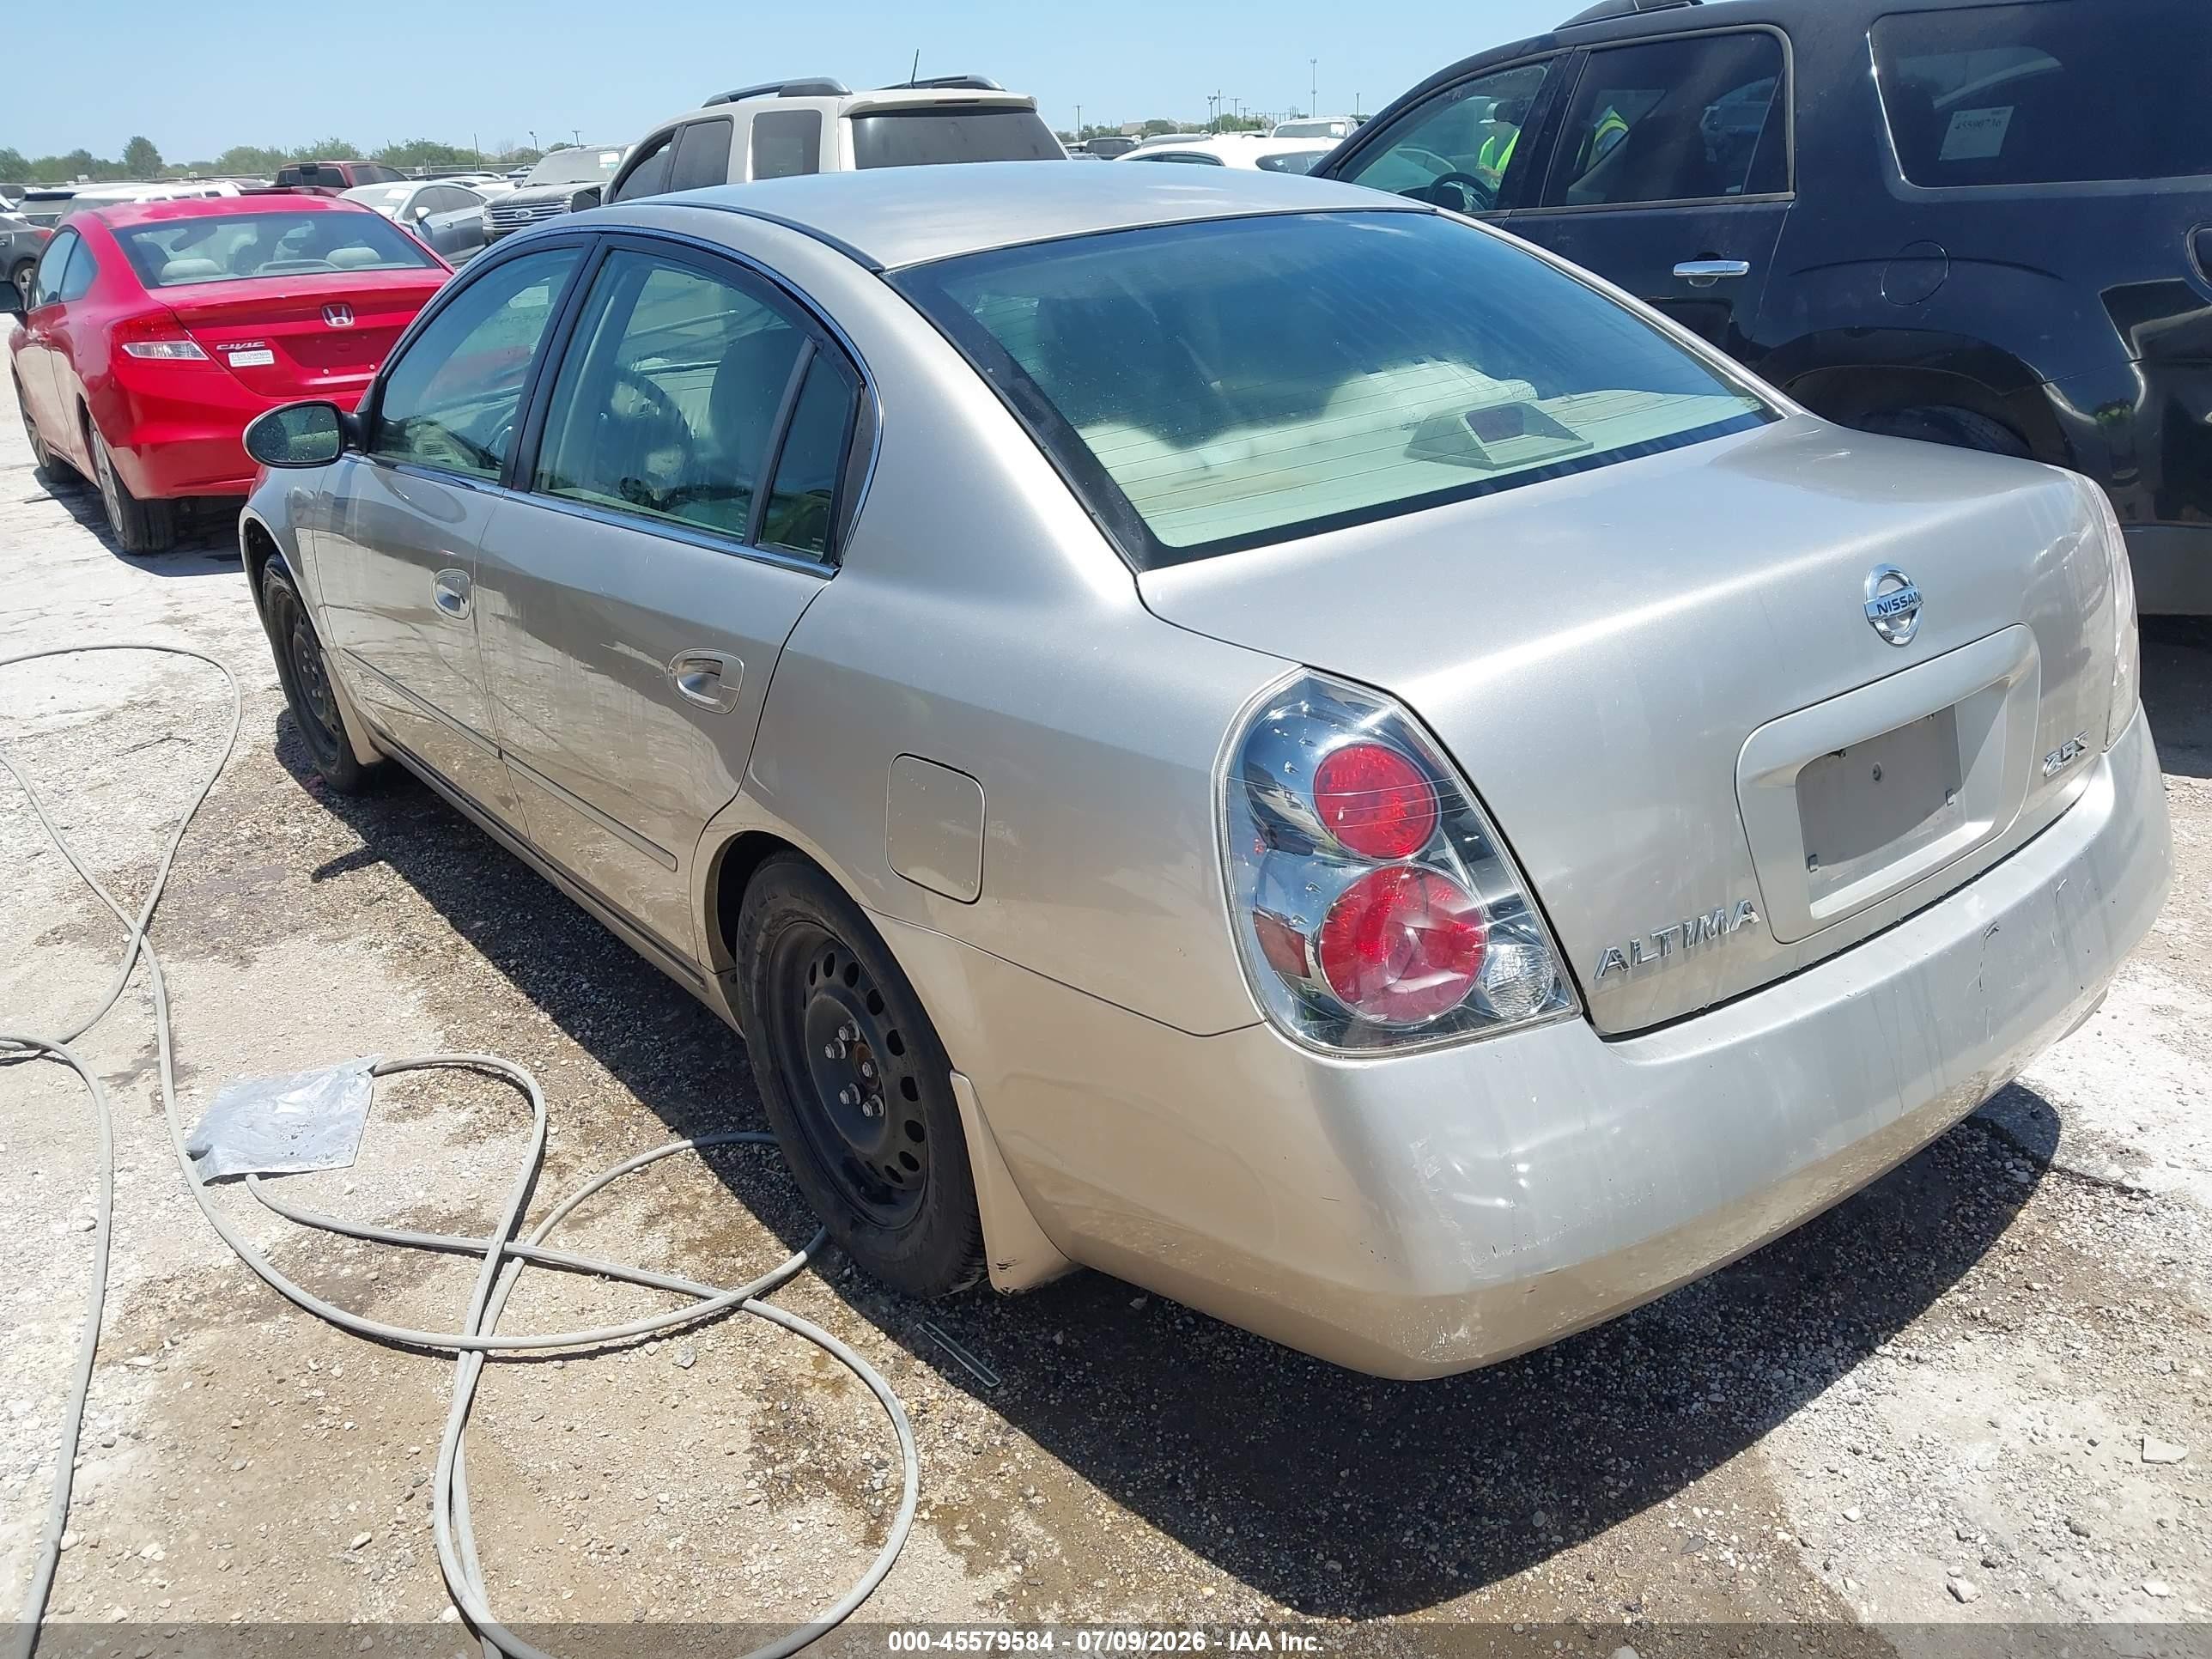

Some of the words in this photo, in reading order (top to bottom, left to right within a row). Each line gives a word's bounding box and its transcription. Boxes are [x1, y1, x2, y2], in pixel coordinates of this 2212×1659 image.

[216, 341, 265, 349] CIVIC
[1876, 591, 1921, 615] NISSAN
[1594, 899, 1760, 979] ALTIMA
